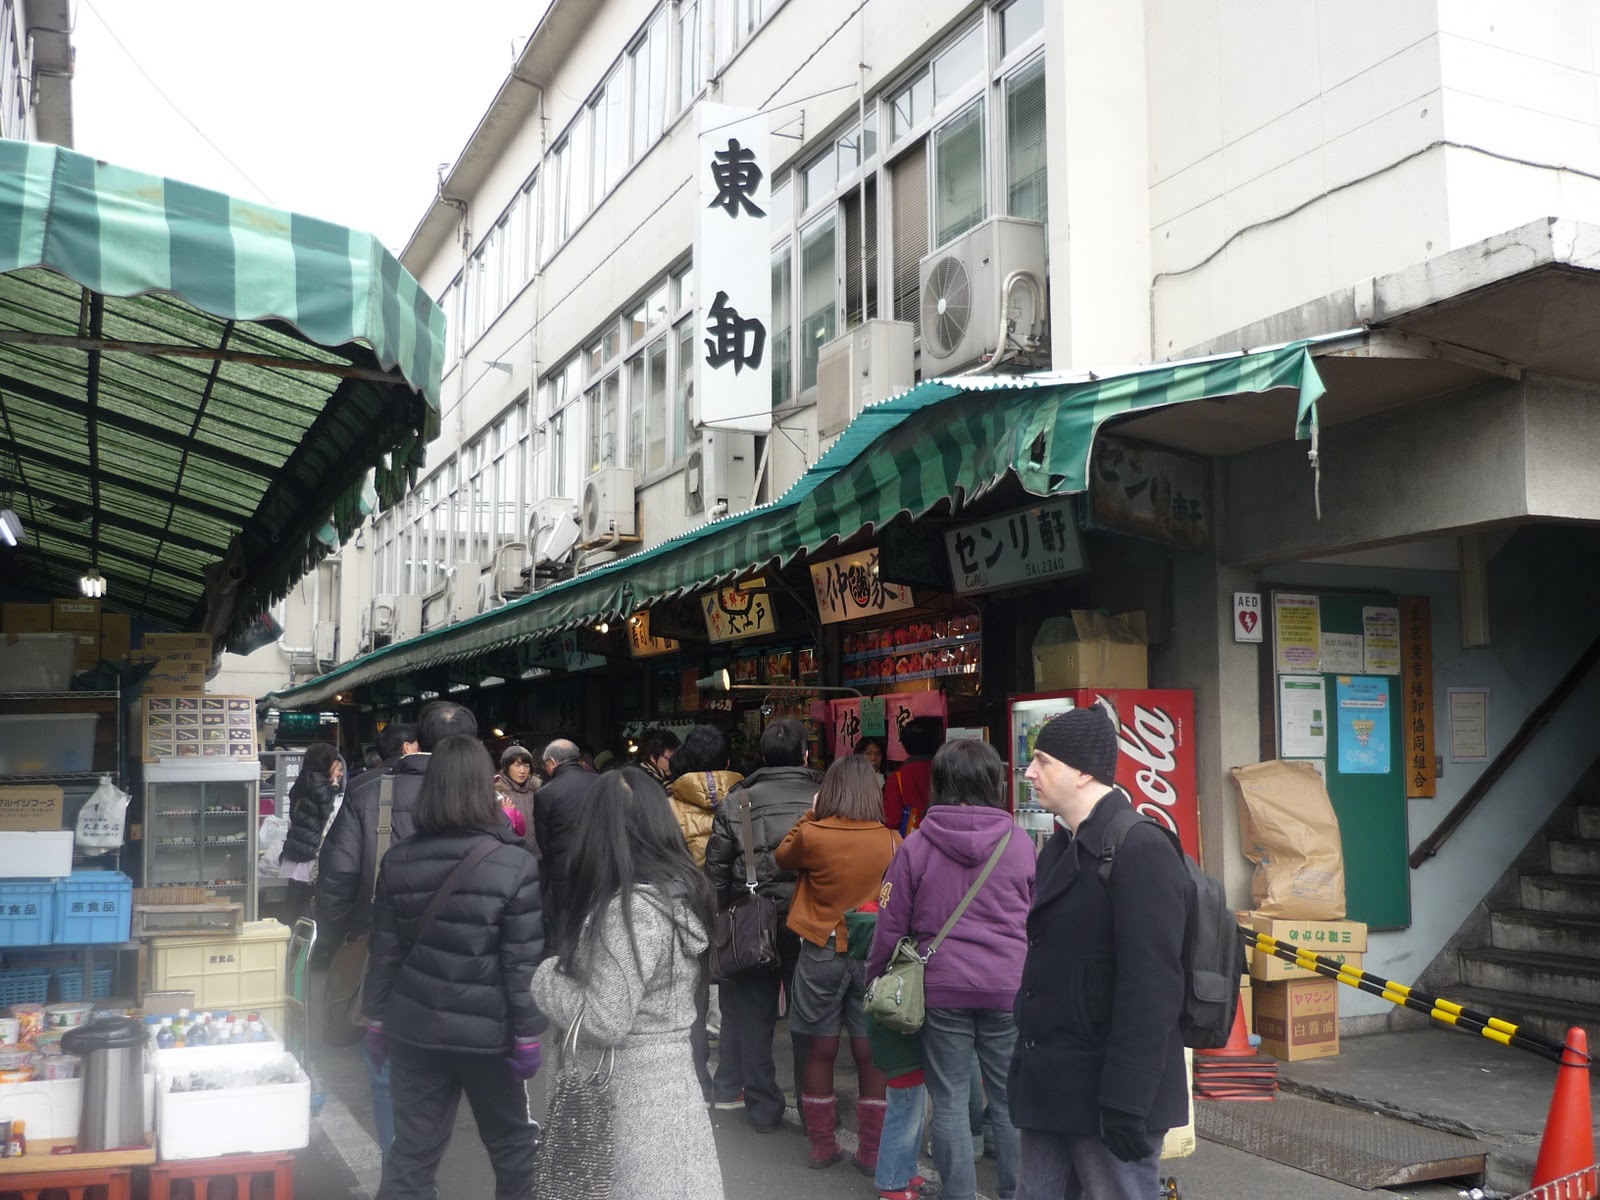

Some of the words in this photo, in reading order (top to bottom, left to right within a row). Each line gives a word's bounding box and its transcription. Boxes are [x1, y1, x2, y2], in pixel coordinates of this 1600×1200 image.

[704, 138, 768, 377] 東卸
[955, 509, 1067, 575] センリ軒
[1025, 559, 1065, 577] 5412240
[1237, 596, 1258, 608] AED
[72, 901, 115, 913] 原食品
[1289, 929, 1351, 943] 三陸わかめ
[210, 954, 235, 964] 原食品
[1293, 991, 1333, 1006] ヤマシン
